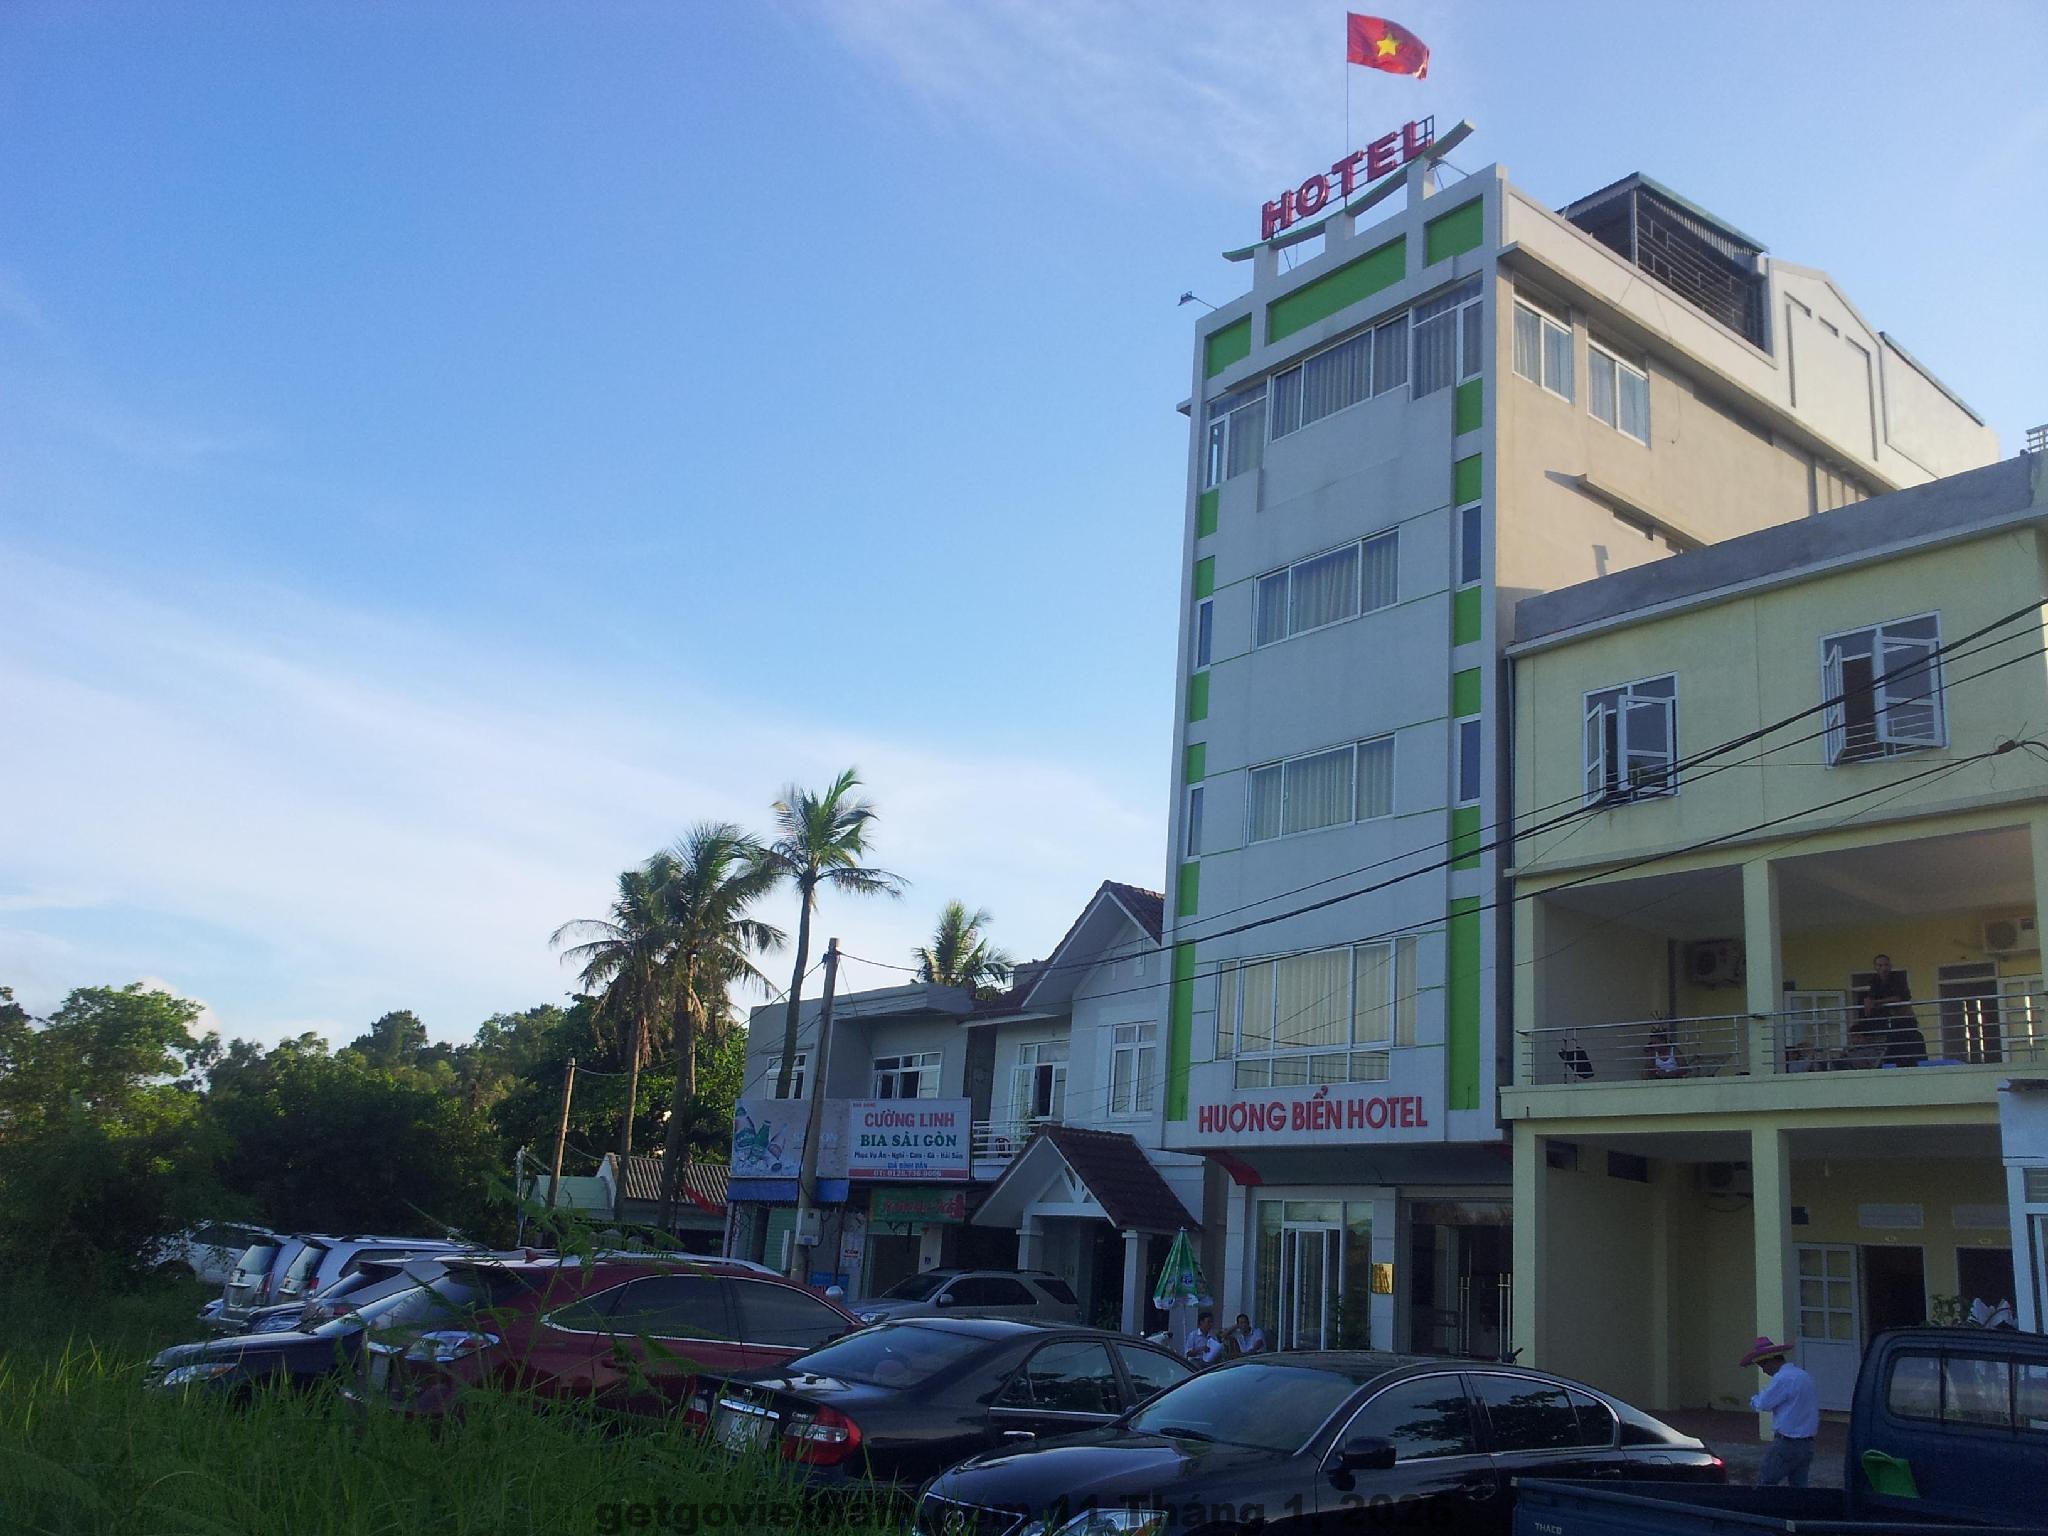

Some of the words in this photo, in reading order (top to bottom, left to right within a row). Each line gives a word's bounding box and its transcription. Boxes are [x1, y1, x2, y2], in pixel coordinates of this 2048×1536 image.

[1261, 119, 1434, 241] HOTEL
[864, 1109, 915, 1128] CƯỜNG
[919, 1112, 955, 1128] LINH
[1291, 1085, 1342, 1131] BIỂN
[1347, 1096, 1428, 1129] HOTEL
[860, 1134, 888, 1147] BIA
[891, 1131, 918, 1147] SÀI
[923, 1131, 957, 1147] GÒN
